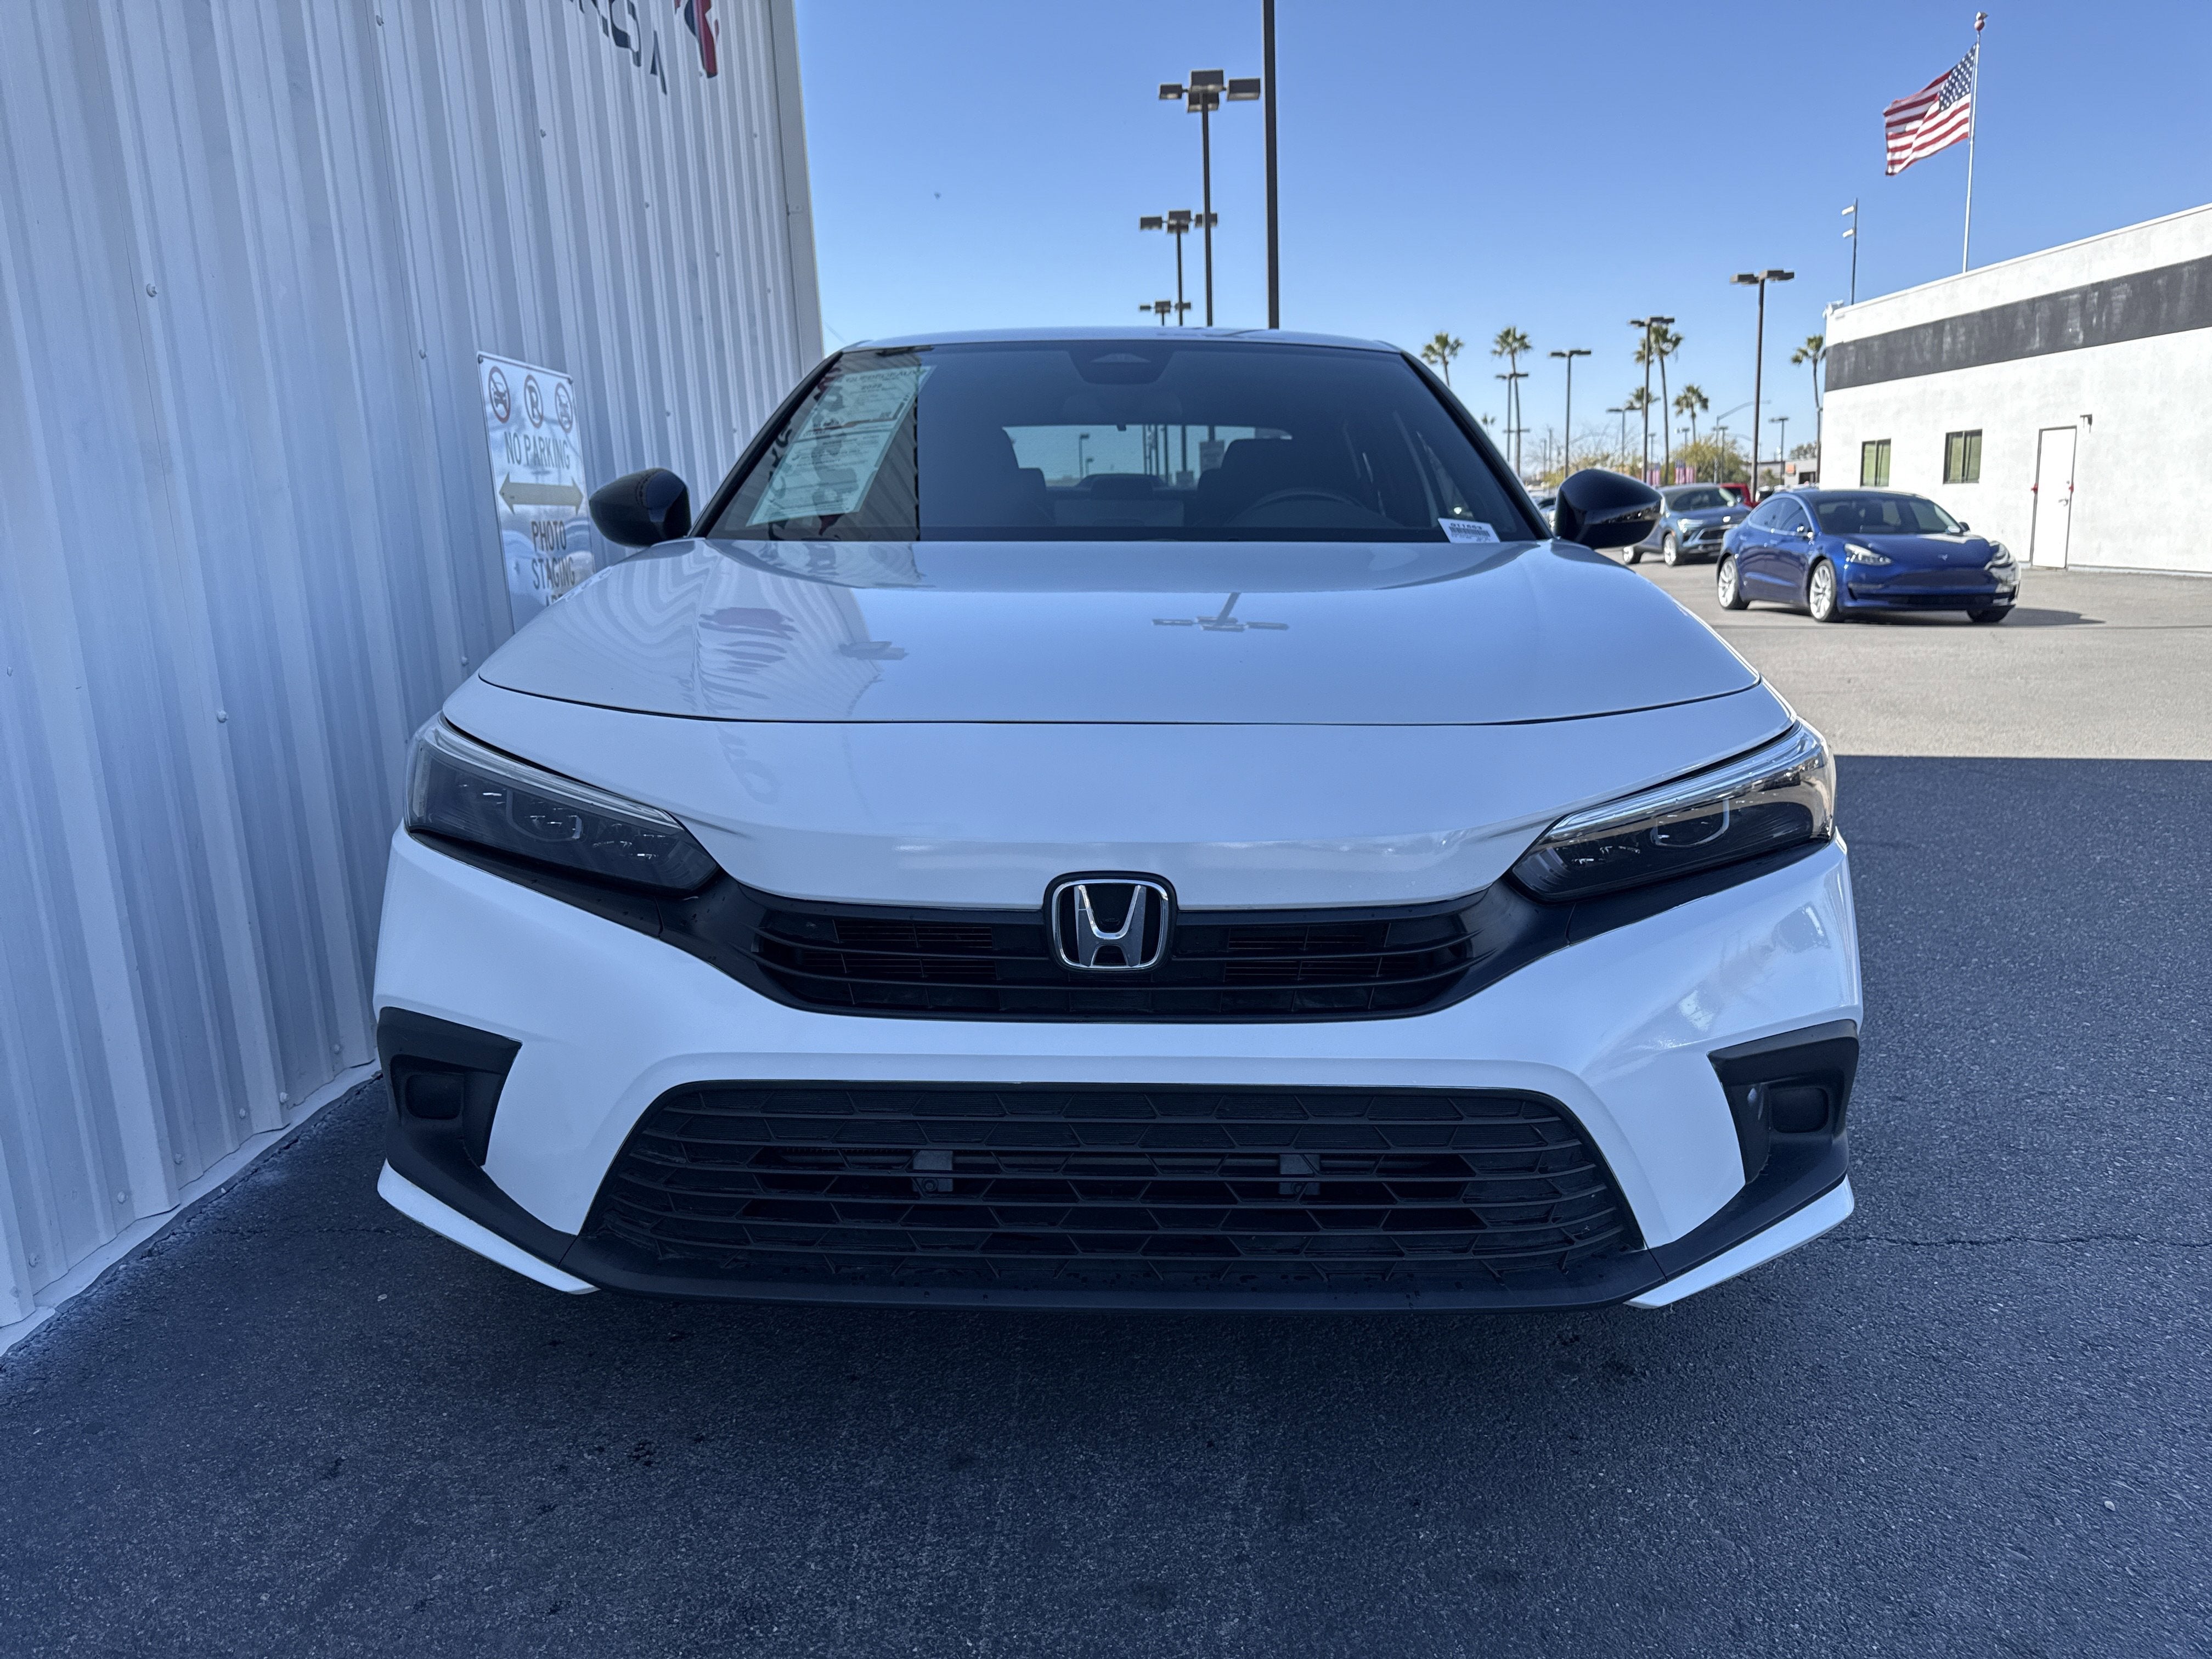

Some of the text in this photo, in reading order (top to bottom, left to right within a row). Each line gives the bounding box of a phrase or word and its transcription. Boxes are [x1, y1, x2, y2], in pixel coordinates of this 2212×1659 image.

[504, 431, 570, 470] NO PARKING
[531, 521, 567, 552] PHOTO
[532, 556, 575, 590] STAGING
